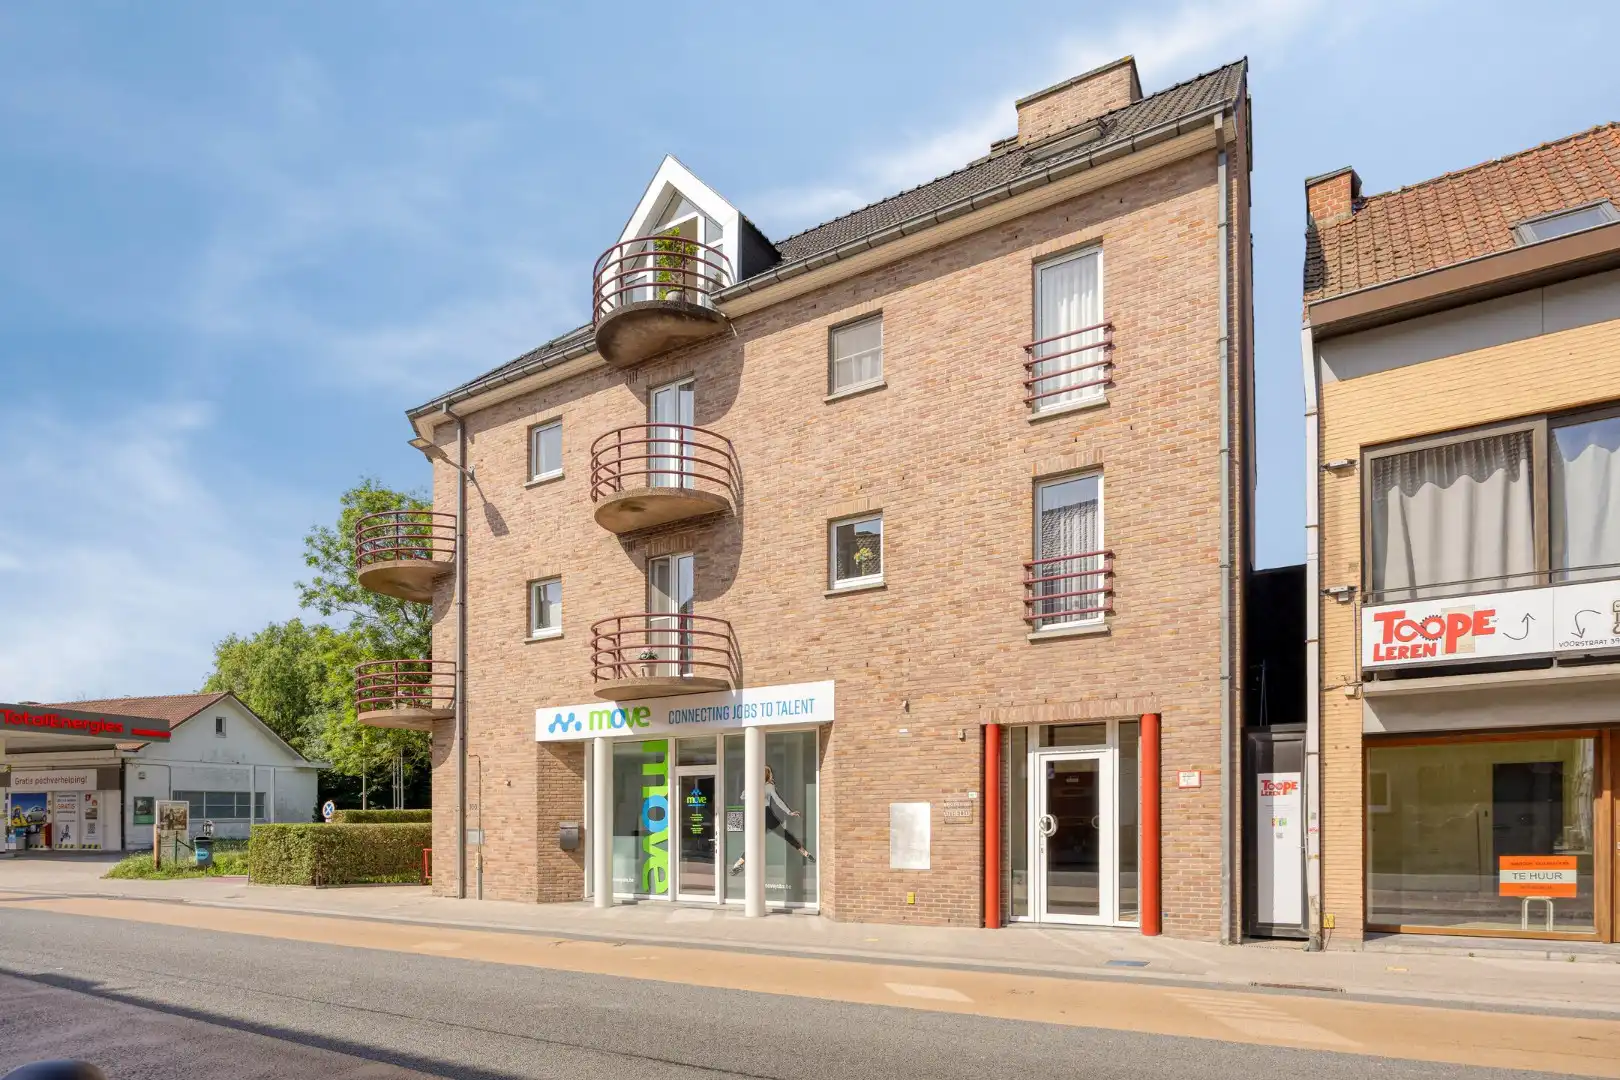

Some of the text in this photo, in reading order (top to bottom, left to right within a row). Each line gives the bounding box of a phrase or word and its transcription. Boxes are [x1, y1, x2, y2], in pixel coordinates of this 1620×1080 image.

[1373, 643, 1437, 662] LEREN
[1558, 639, 1607, 647] VOORSTRAAT
[3, 709, 124, 735] TotalEnergies
[589, 706, 651, 731] move
[668, 698, 815, 725] CONNECTING JOBS TO TALENT
[14, 777, 33, 785] Gratis
[641, 739, 669, 895] move
[1512, 872, 1562, 881] TE HUUR
